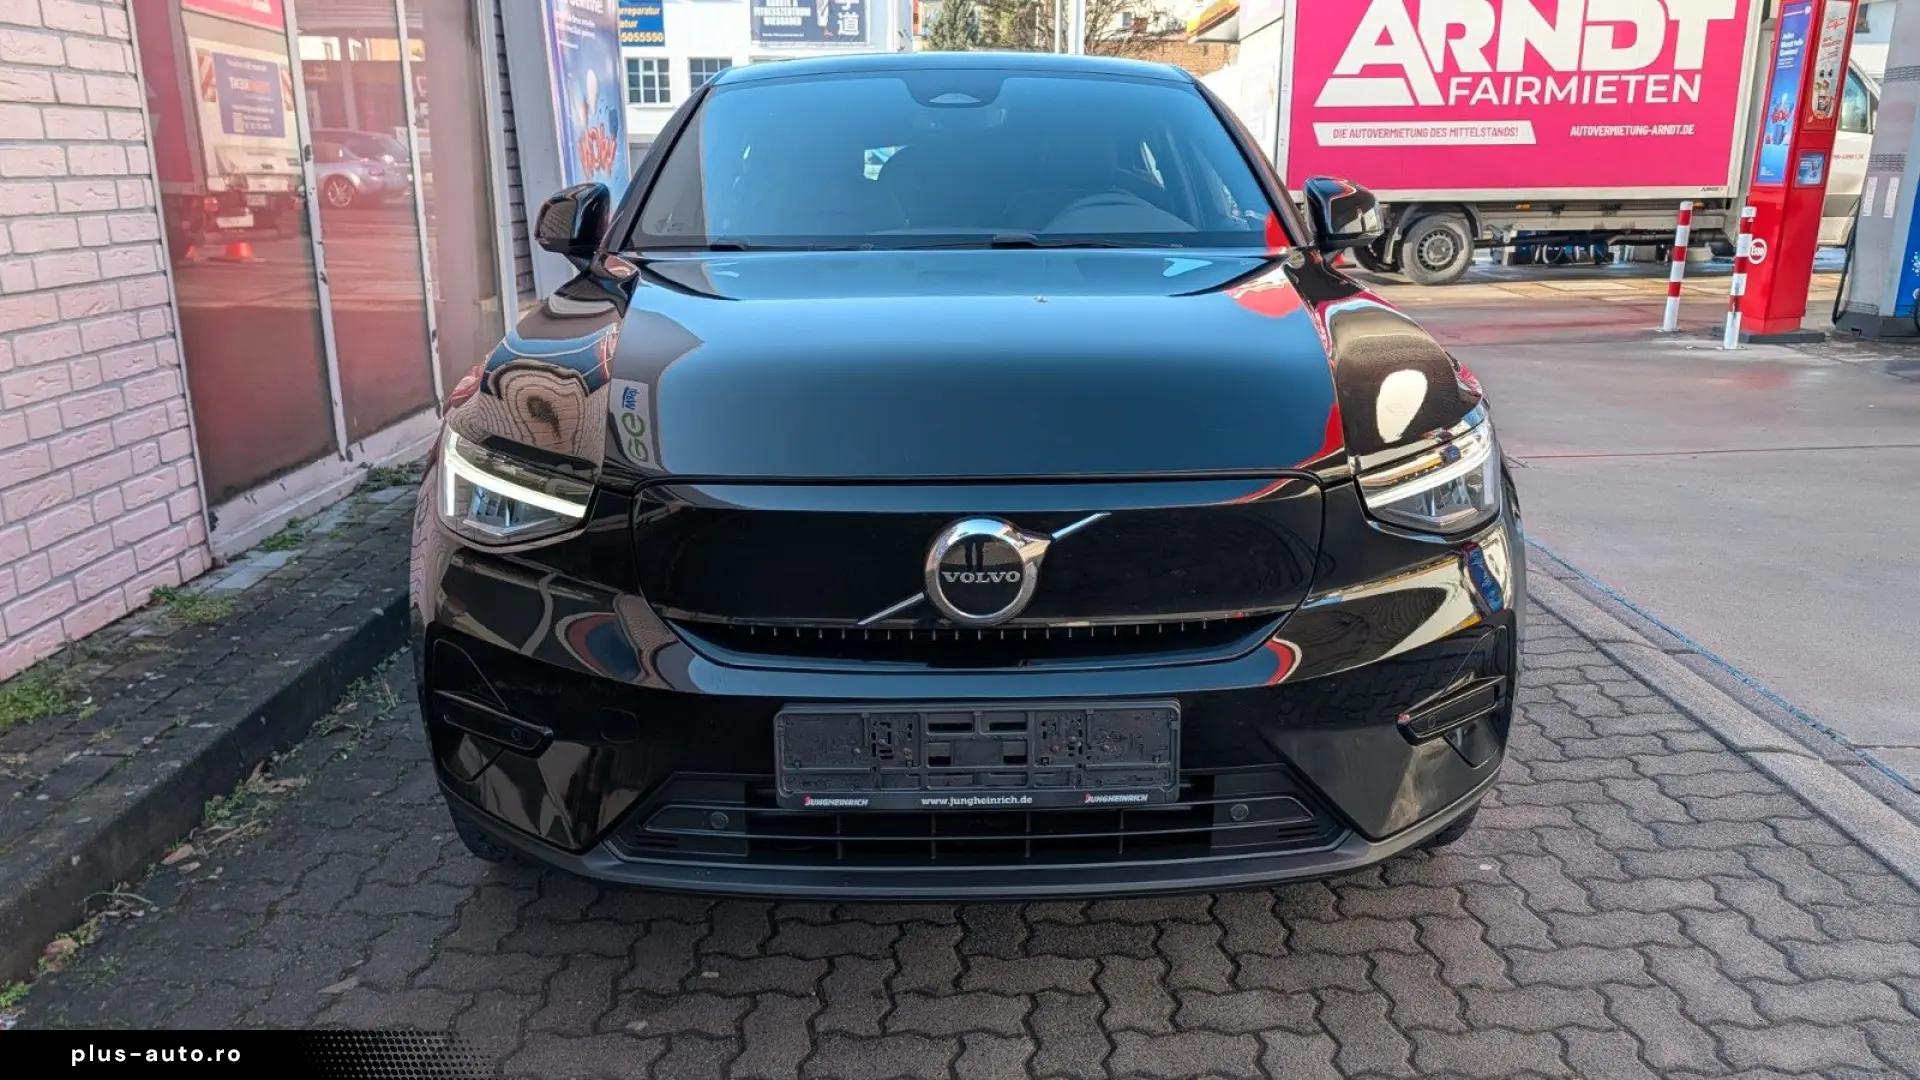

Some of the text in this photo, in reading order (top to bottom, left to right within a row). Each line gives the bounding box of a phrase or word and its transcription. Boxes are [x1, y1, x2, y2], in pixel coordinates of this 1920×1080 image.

[1314, 0, 1736, 107] ARNDT
[1447, 74, 1702, 106] FAIRMIETEN
[1332, 126, 1519, 139] DIE AUTOVERMIETUNG DES MITTELSTANDS!
[1569, 124, 1696, 137] AUTOVERMIETUNG-ARNDT.DE
[941, 570, 1021, 583] VOLVO
[804, 793, 869, 806] JUNGHEINRICH
[921, 795, 1033, 808] www.jungheinrich.de
[1085, 792, 1149, 804] JUNGHEINRICH
